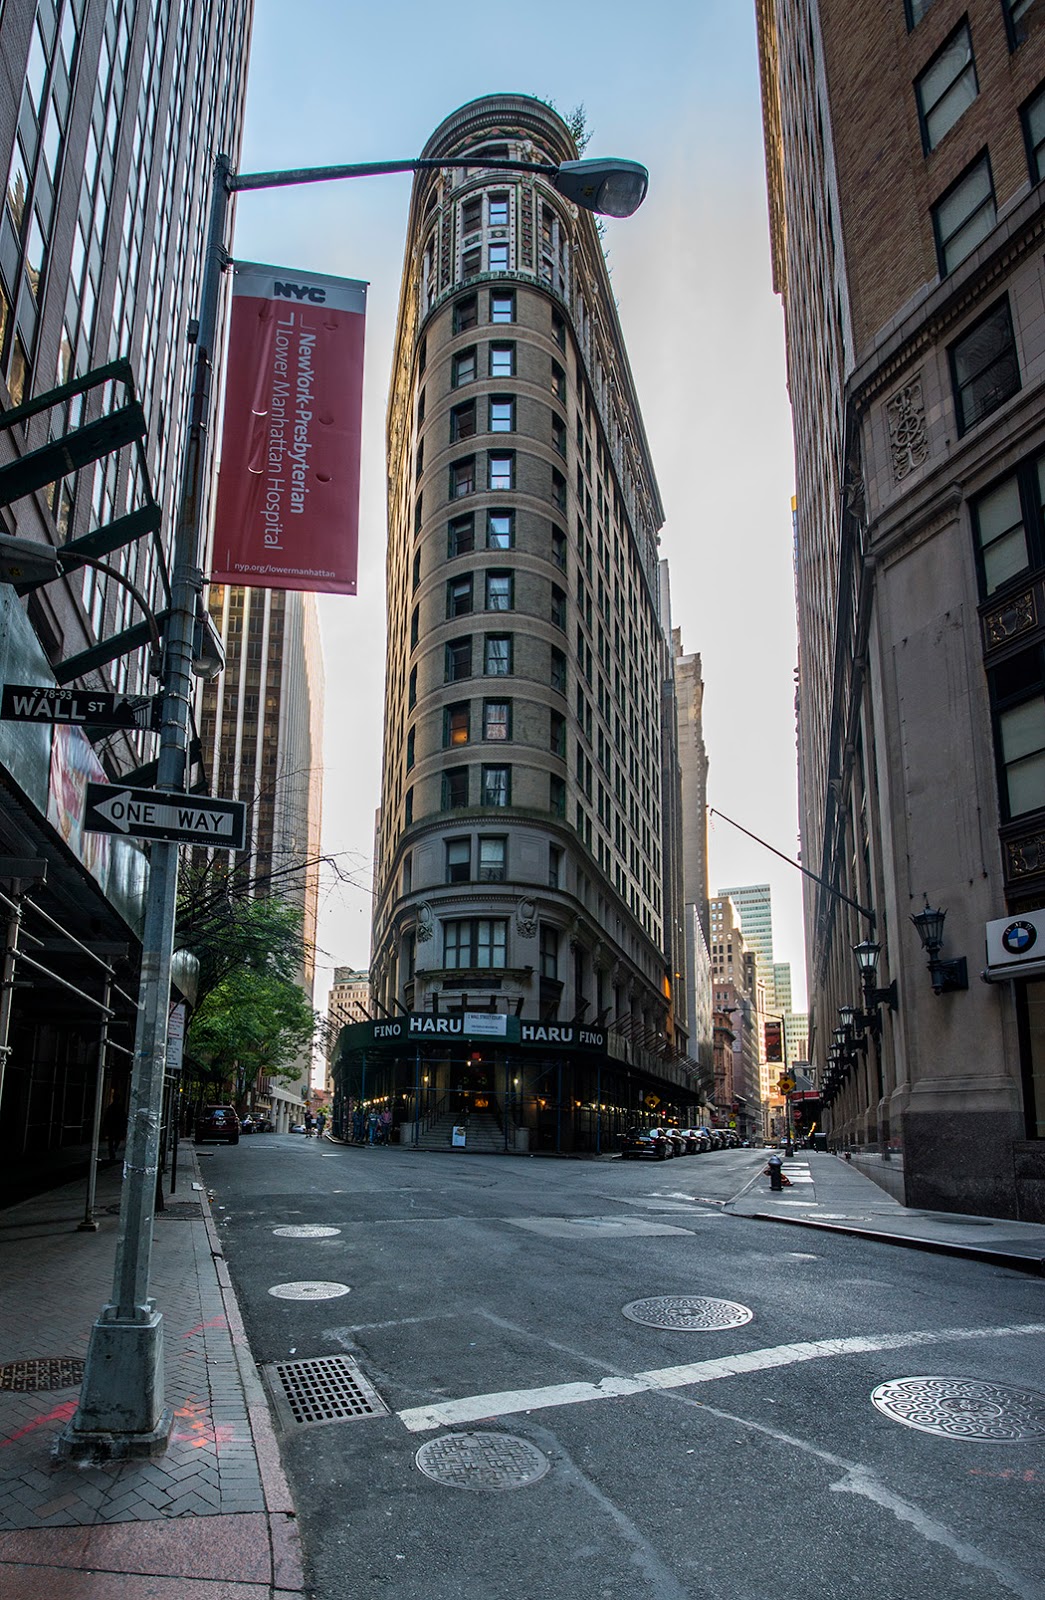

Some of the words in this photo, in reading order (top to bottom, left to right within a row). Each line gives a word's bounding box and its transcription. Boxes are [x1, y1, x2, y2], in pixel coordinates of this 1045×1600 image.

[274, 281, 326, 303] NYC
[273, 329, 290, 379] Lower
[266, 381, 291, 474] Manhattan
[290, 333, 317, 514] NewYork-Presbyterian
[263, 479, 285, 550] Hospital
[234, 562, 336, 578] nyp.org/lowermanhattan
[43, 689, 73, 700] 78-93
[13, 695, 86, 720] WALL
[88, 702, 105, 712] ST
[111, 801, 156, 823] ONE
[178, 809, 224, 832] WAY
[374, 1024, 401, 1038] FINO
[410, 1017, 462, 1033] HARU
[522, 1025, 573, 1042] HARU
[579, 1031, 603, 1045] FINO
